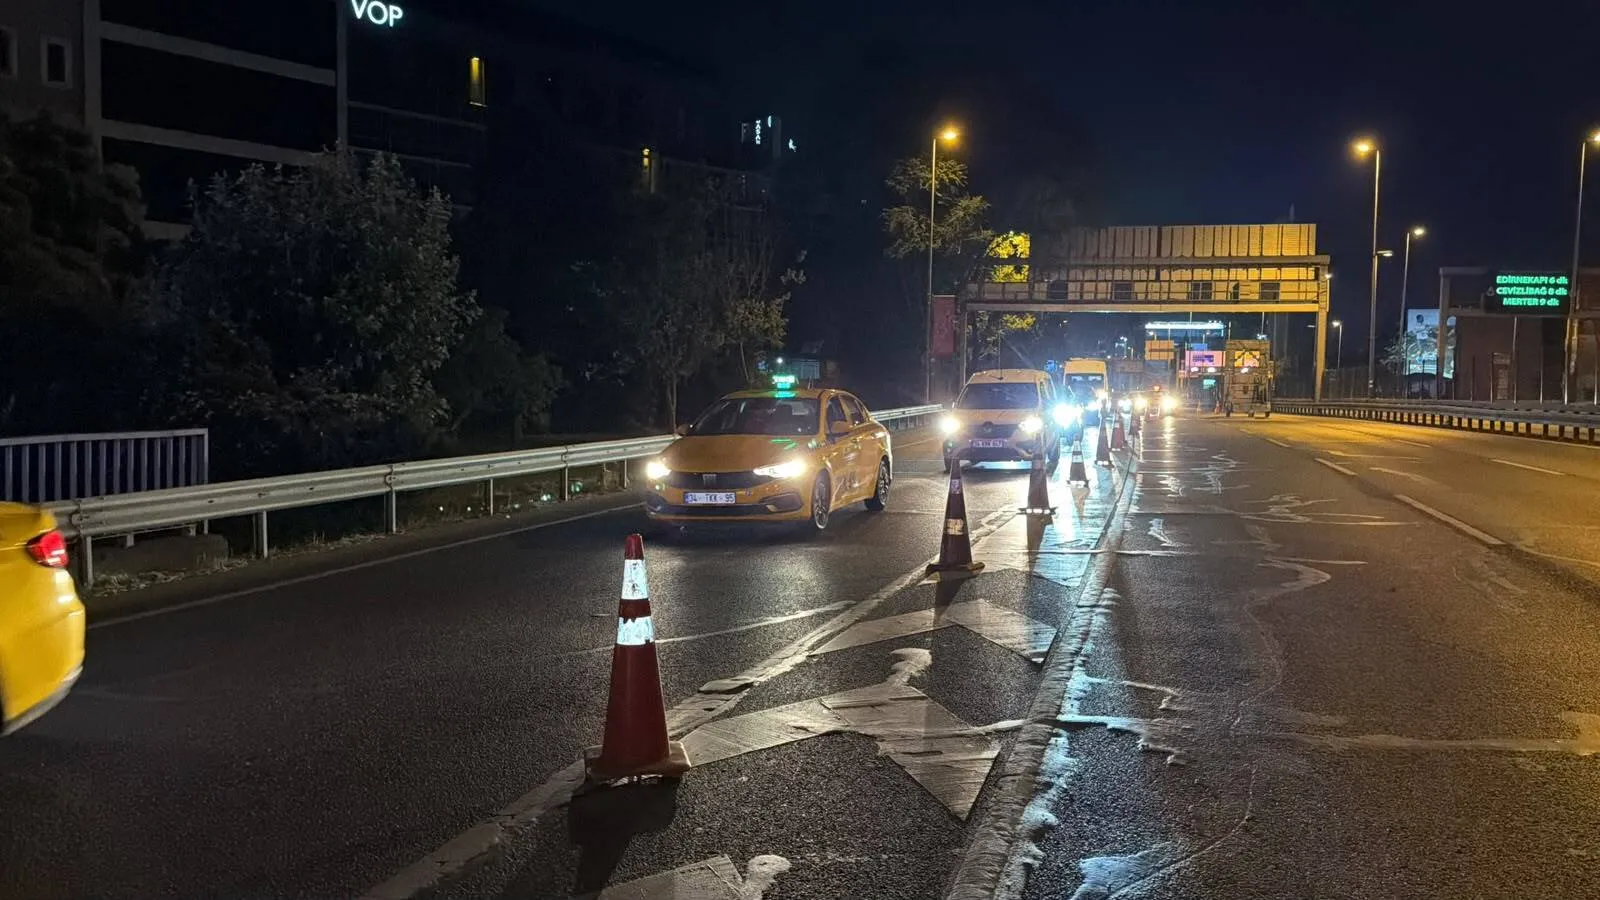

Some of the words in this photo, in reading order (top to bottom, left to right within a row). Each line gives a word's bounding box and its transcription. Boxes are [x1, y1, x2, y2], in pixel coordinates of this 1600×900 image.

[351, 0, 404, 27] VOP
[1496, 275, 1548, 284] EDİRNEKAPI
[1549, 276, 1556, 284] 6
[1556, 276, 1568, 284] dk
[1496, 286, 1547, 295] CEVİZLİBAĞ
[1555, 287, 1568, 295] dk
[1503, 297, 1539, 306] MERTER
[1539, 298, 1546, 306] 9
[1547, 297, 1560, 306] dk
